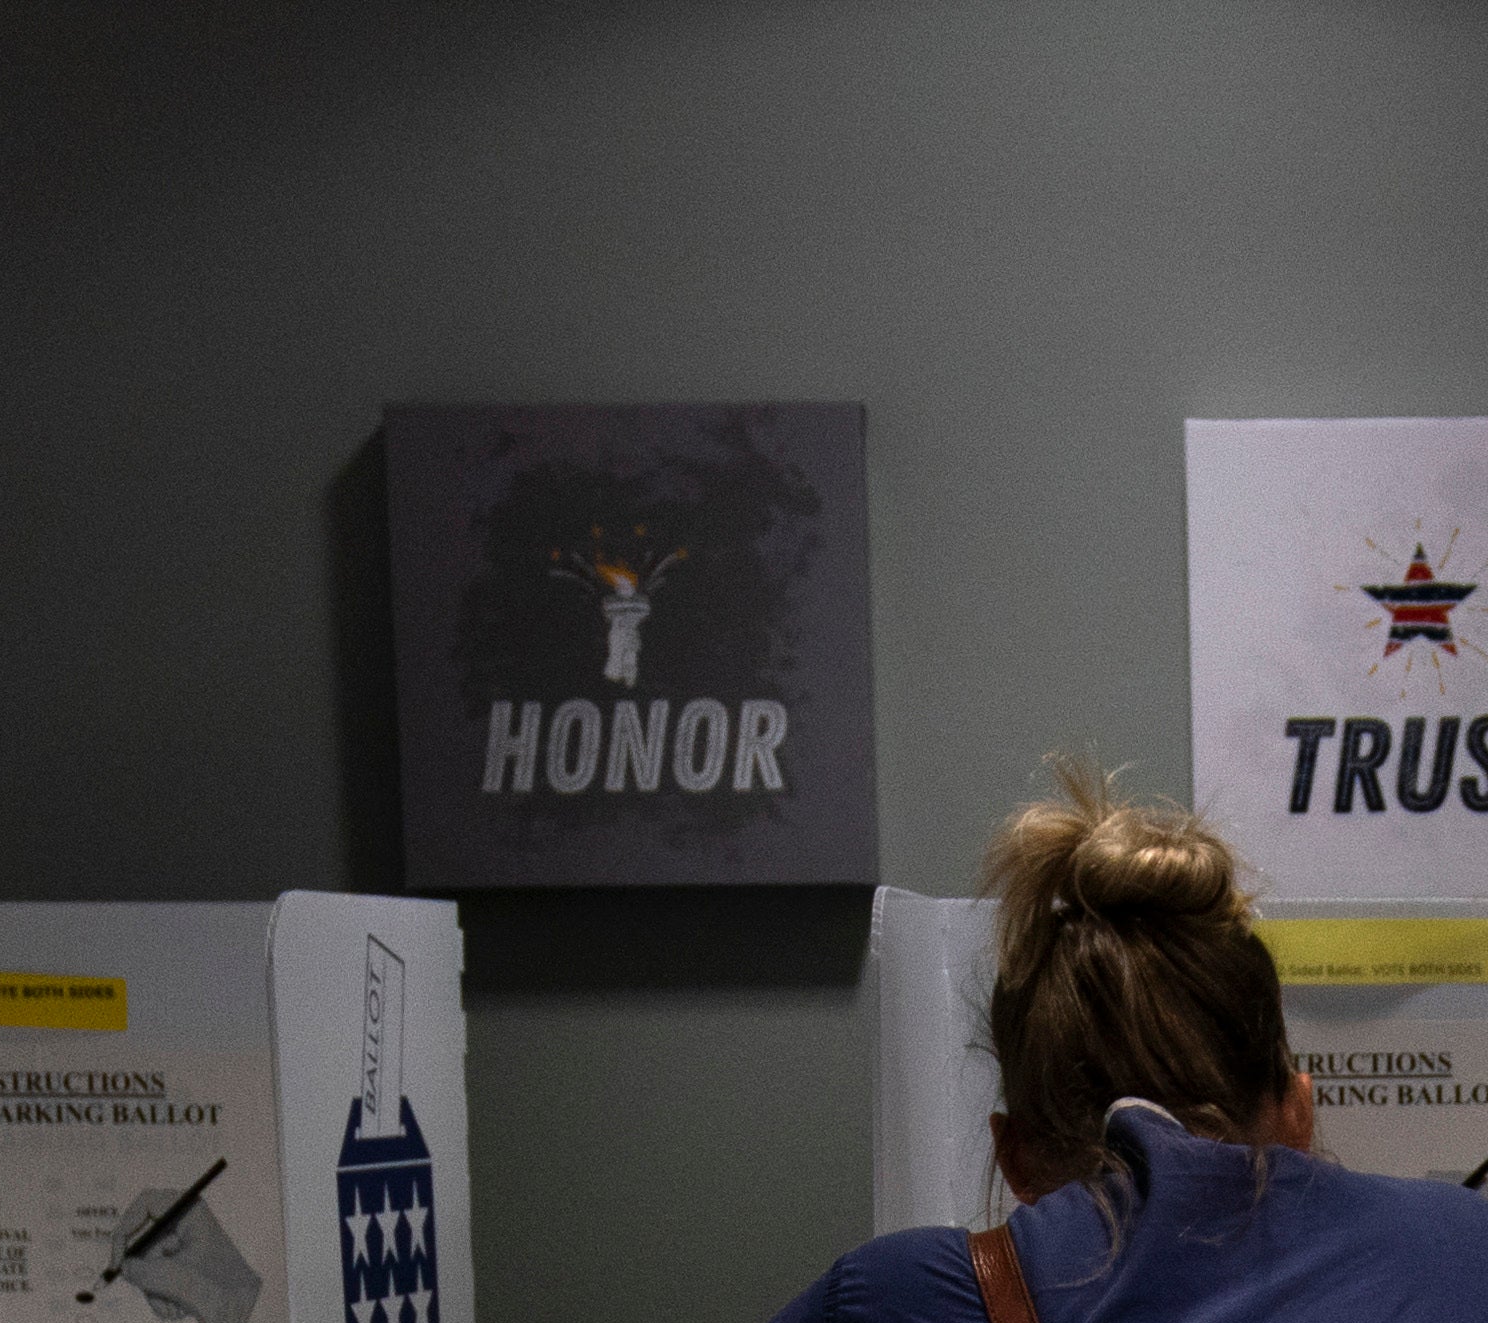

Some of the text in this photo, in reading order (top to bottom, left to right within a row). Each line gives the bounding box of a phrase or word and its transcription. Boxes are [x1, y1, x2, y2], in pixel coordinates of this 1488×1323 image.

[481, 697, 788, 793] HONOR
[21, 985, 63, 999] BOTH
[68, 985, 116, 1000] SIDES
[363, 967, 381, 1115] BALLOT
[1291, 1053, 1453, 1079] TRUCTIONS
[1314, 1086, 1388, 1107] KING
[111, 1103, 221, 1126] BALLOT
[5, 1245, 27, 1260] OF
